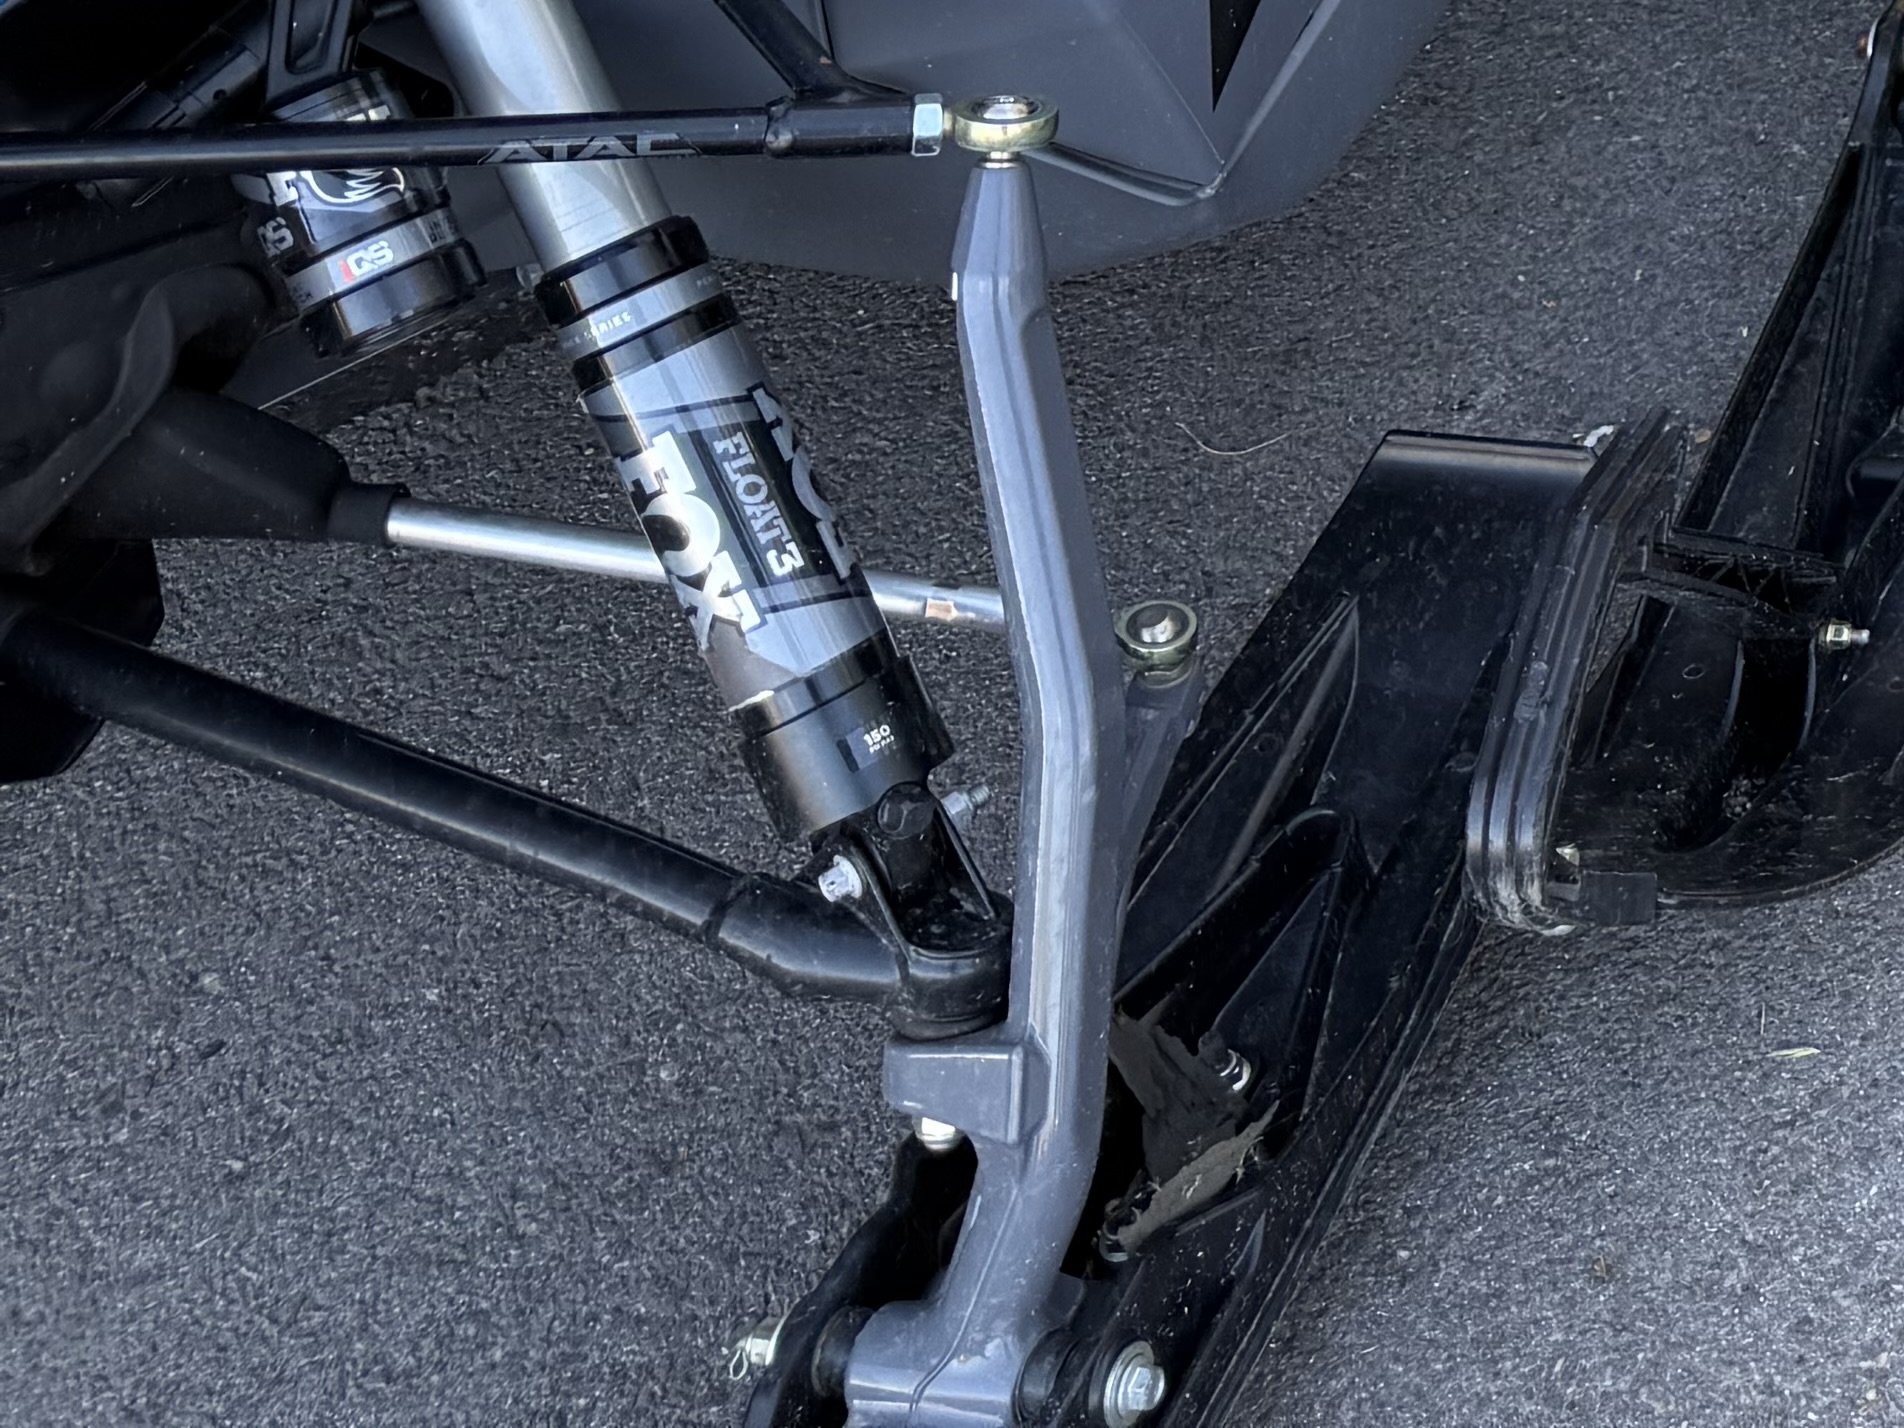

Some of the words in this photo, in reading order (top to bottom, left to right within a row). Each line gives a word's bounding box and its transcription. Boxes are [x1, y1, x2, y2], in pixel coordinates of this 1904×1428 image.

[618, 430, 761, 651] FOX
[713, 432, 792, 546] FLOAT
[767, 543, 805, 577] 3
[863, 724, 890, 746] 150
